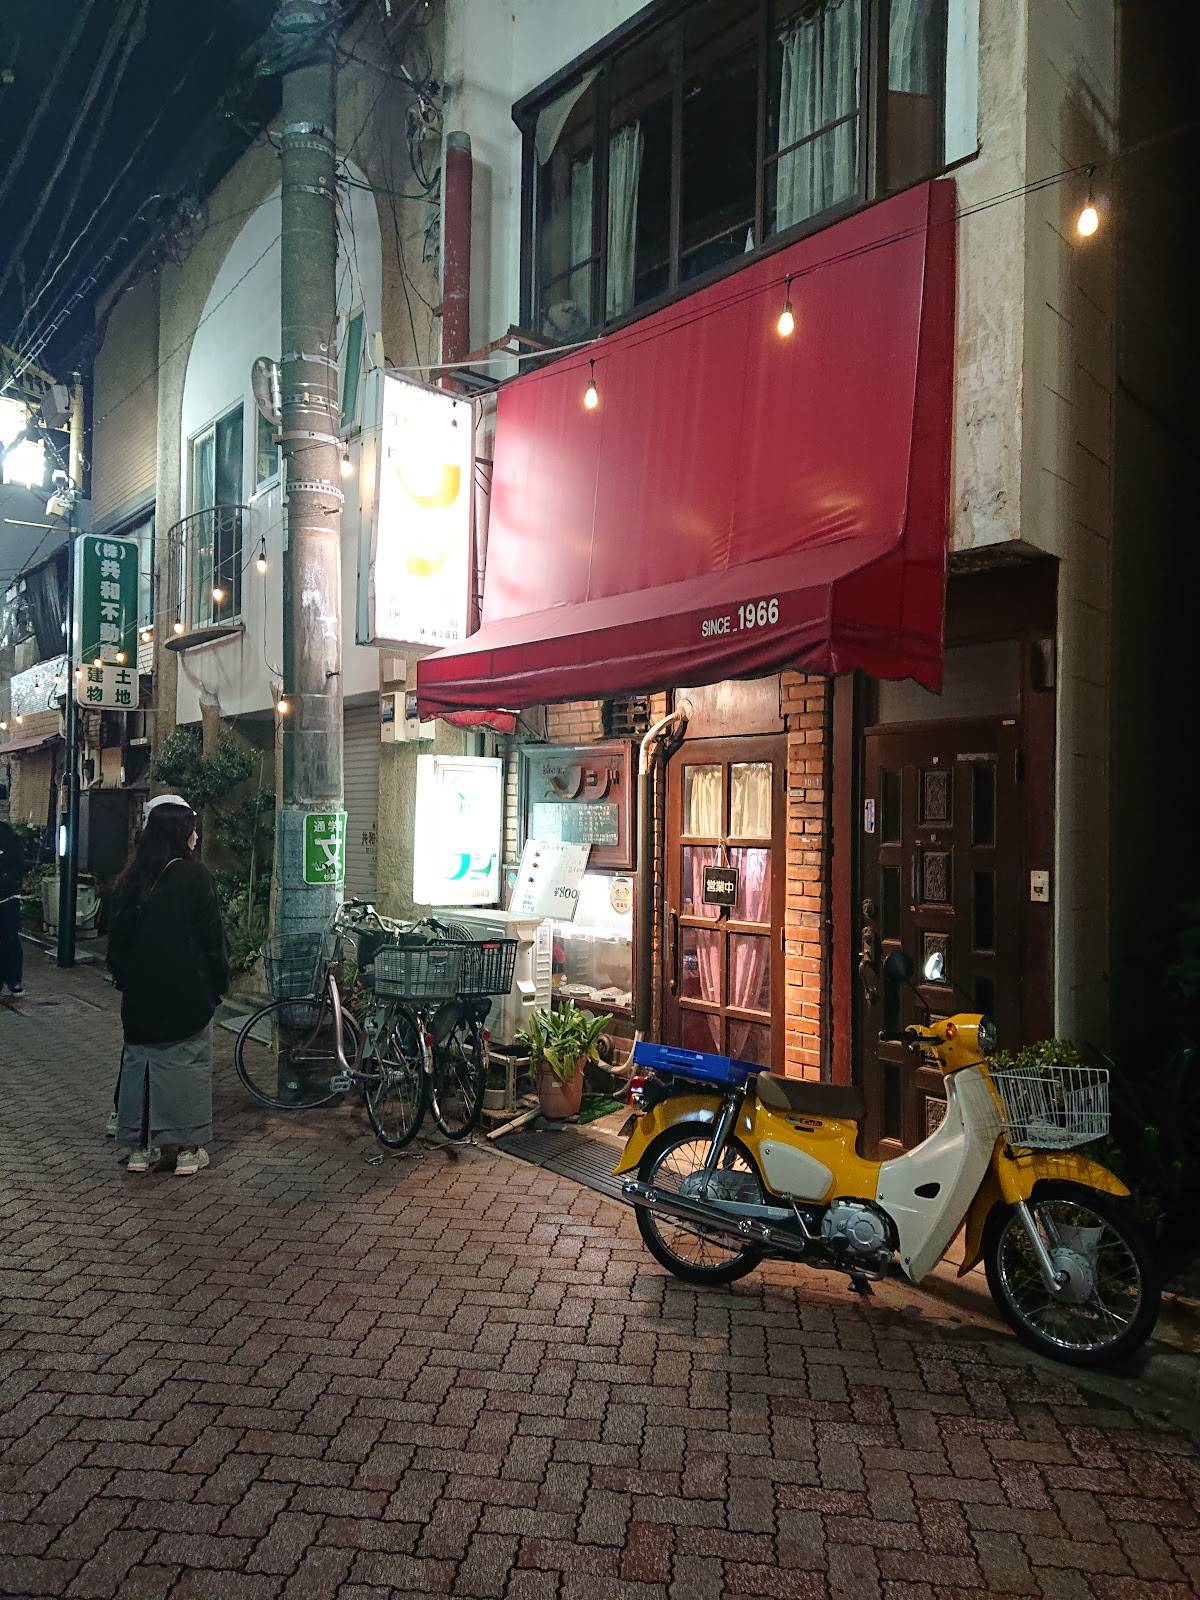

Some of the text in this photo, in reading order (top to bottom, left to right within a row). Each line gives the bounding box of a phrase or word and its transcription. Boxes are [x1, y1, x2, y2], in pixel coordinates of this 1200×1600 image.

[701, 598, 779, 637] SINCE 1966
[86, 666, 104, 703] 建物
[114, 669, 132, 705] 土地
[553, 886, 579, 899] ¥800
[706, 879, 734, 894] 営業中
